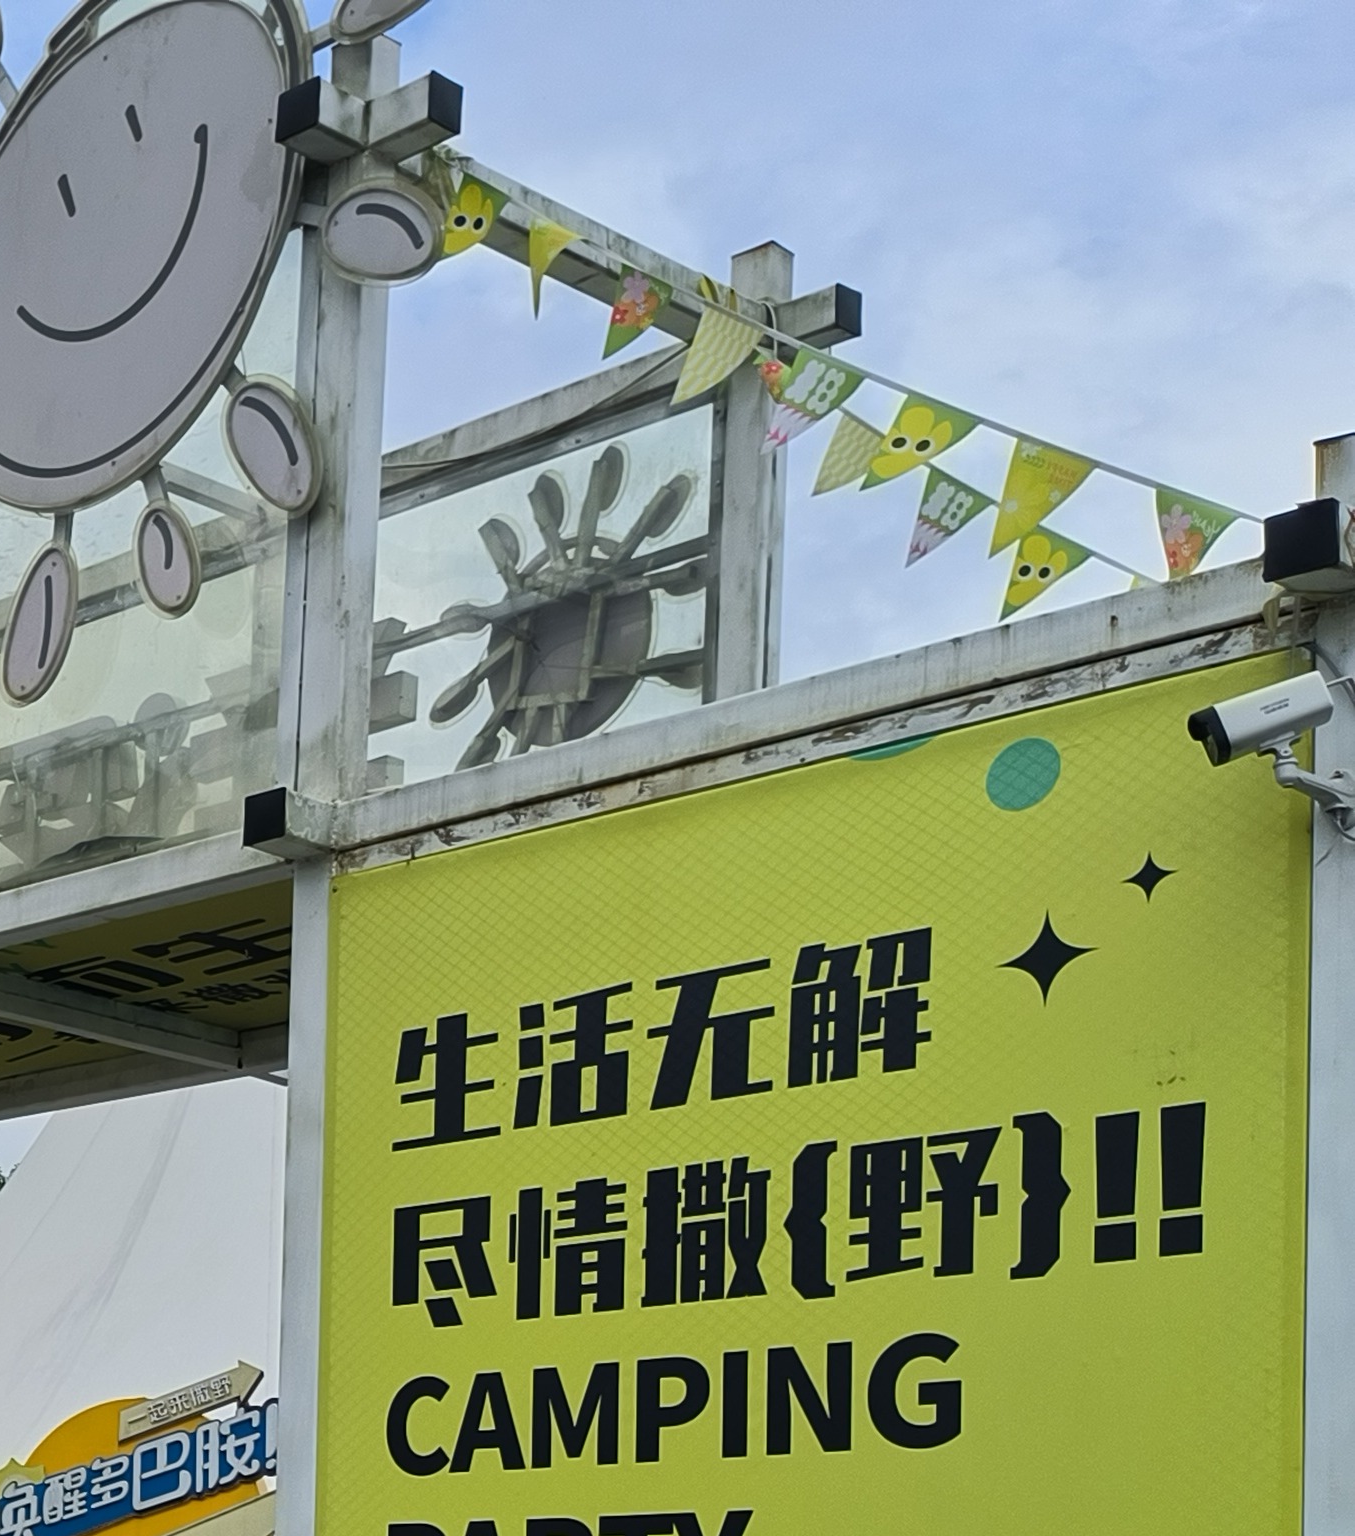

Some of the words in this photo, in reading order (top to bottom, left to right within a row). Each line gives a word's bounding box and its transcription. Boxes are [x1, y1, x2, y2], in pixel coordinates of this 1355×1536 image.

[391, 926, 934, 1152] 生活无解
[385, 1331, 964, 1477] CAMPING
